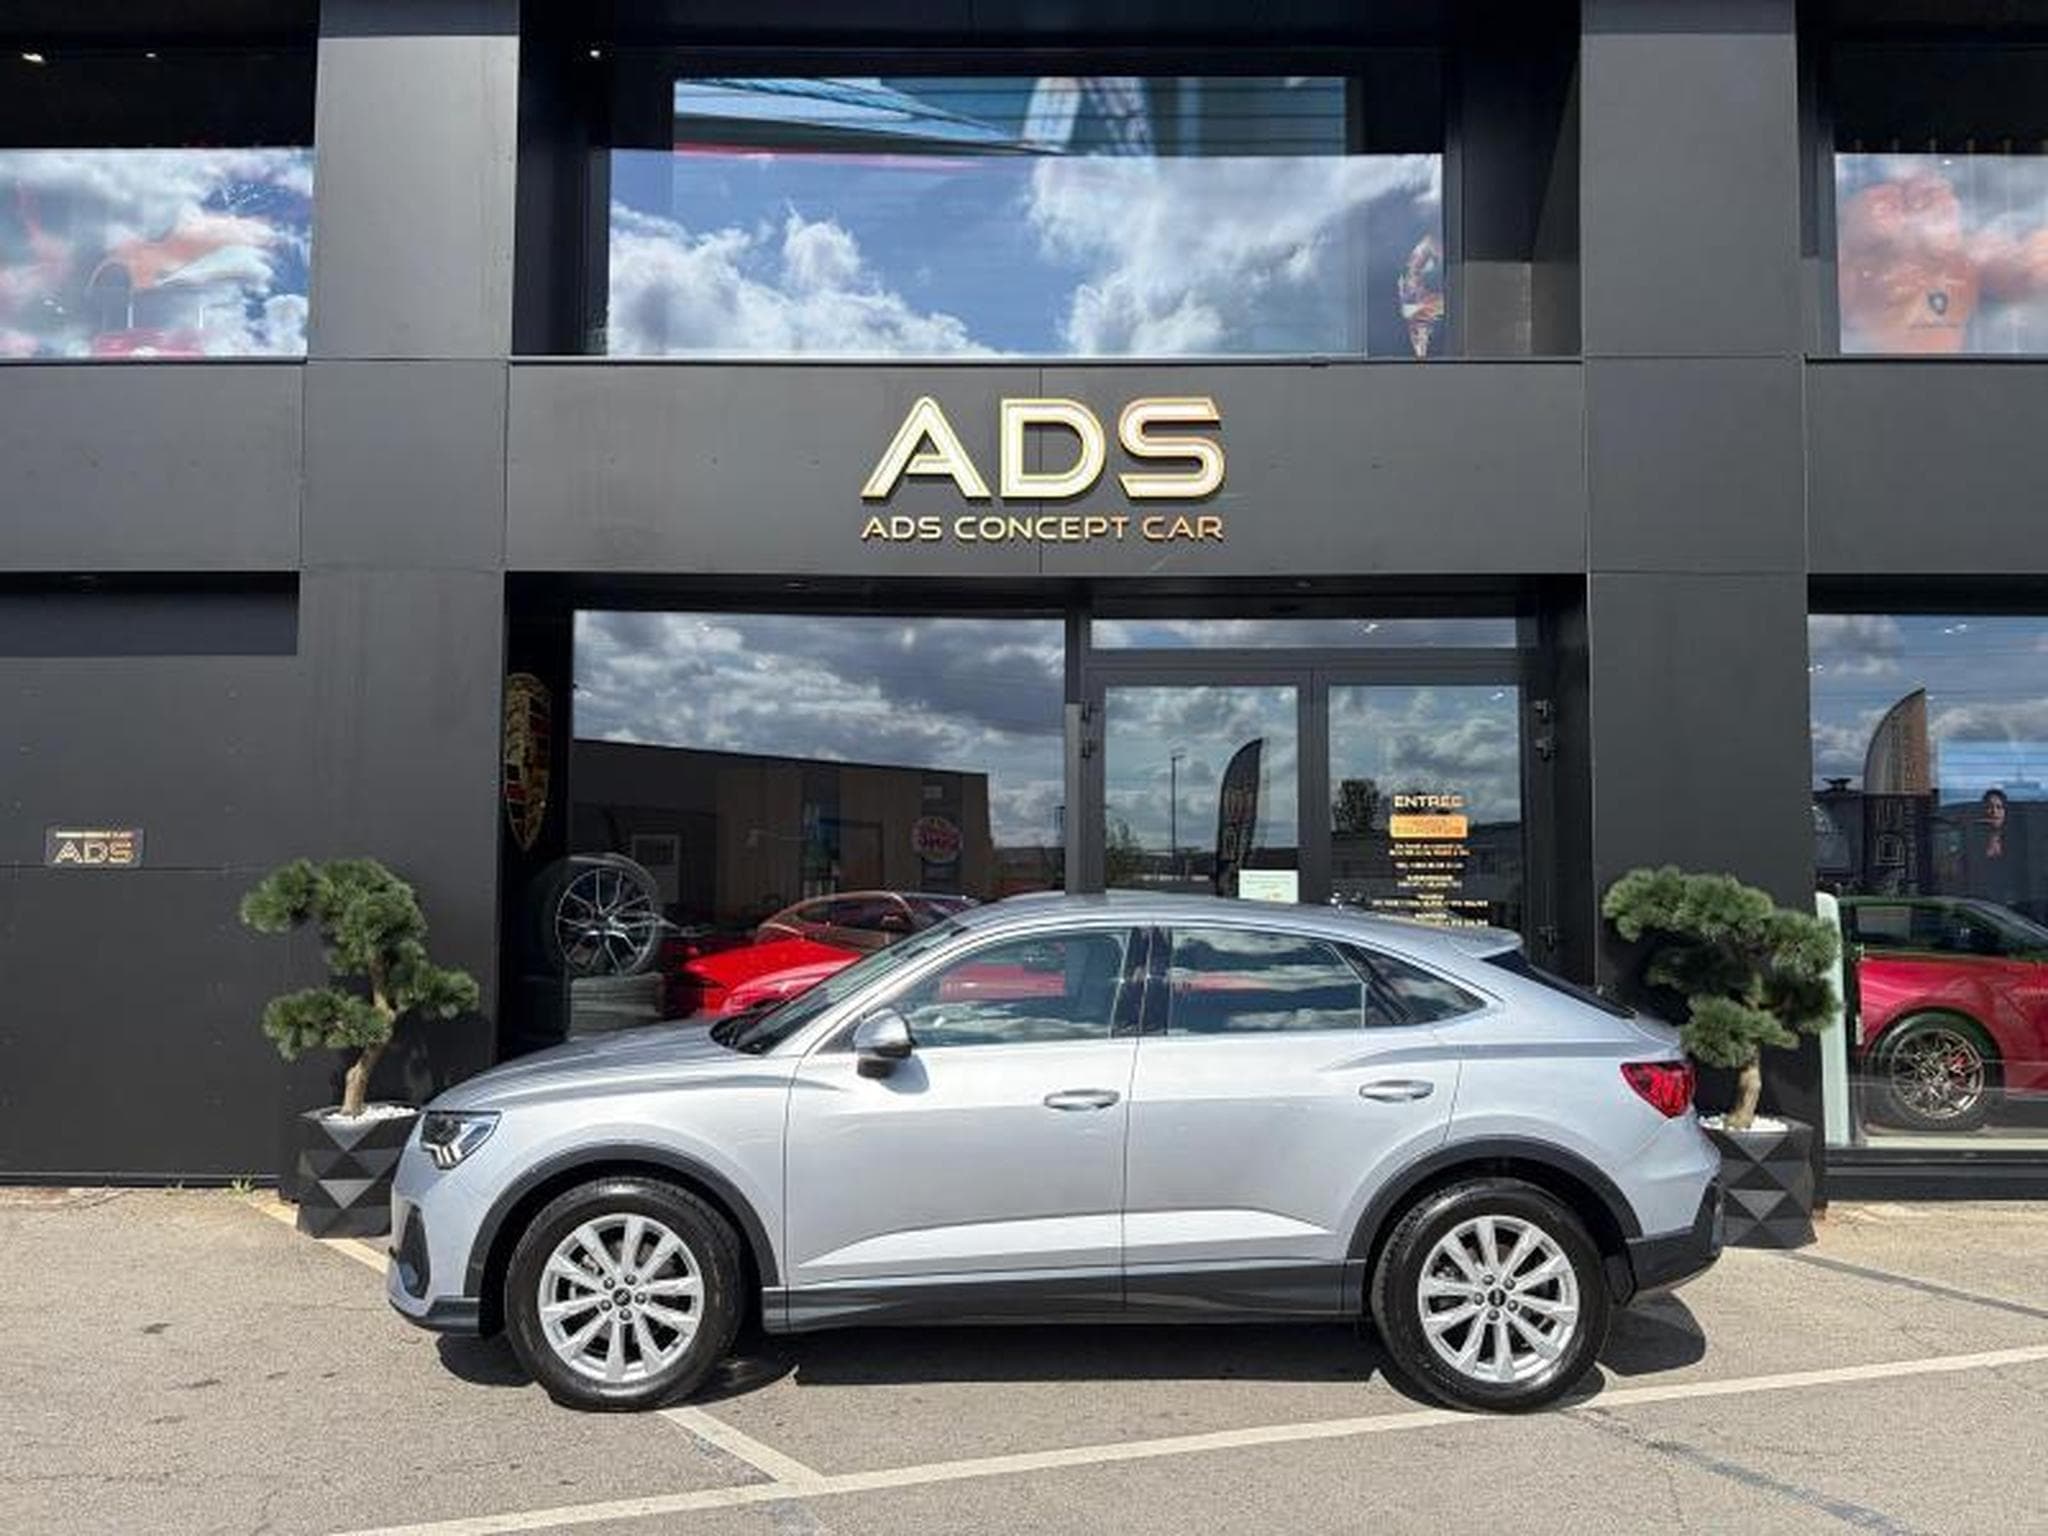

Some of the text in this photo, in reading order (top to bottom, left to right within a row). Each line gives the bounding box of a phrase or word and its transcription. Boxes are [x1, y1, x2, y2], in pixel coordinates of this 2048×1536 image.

[860, 395, 1226, 500] ADS
[861, 516, 1224, 542] ADS CONCEPT CAR
[53, 840, 134, 864] ADS
